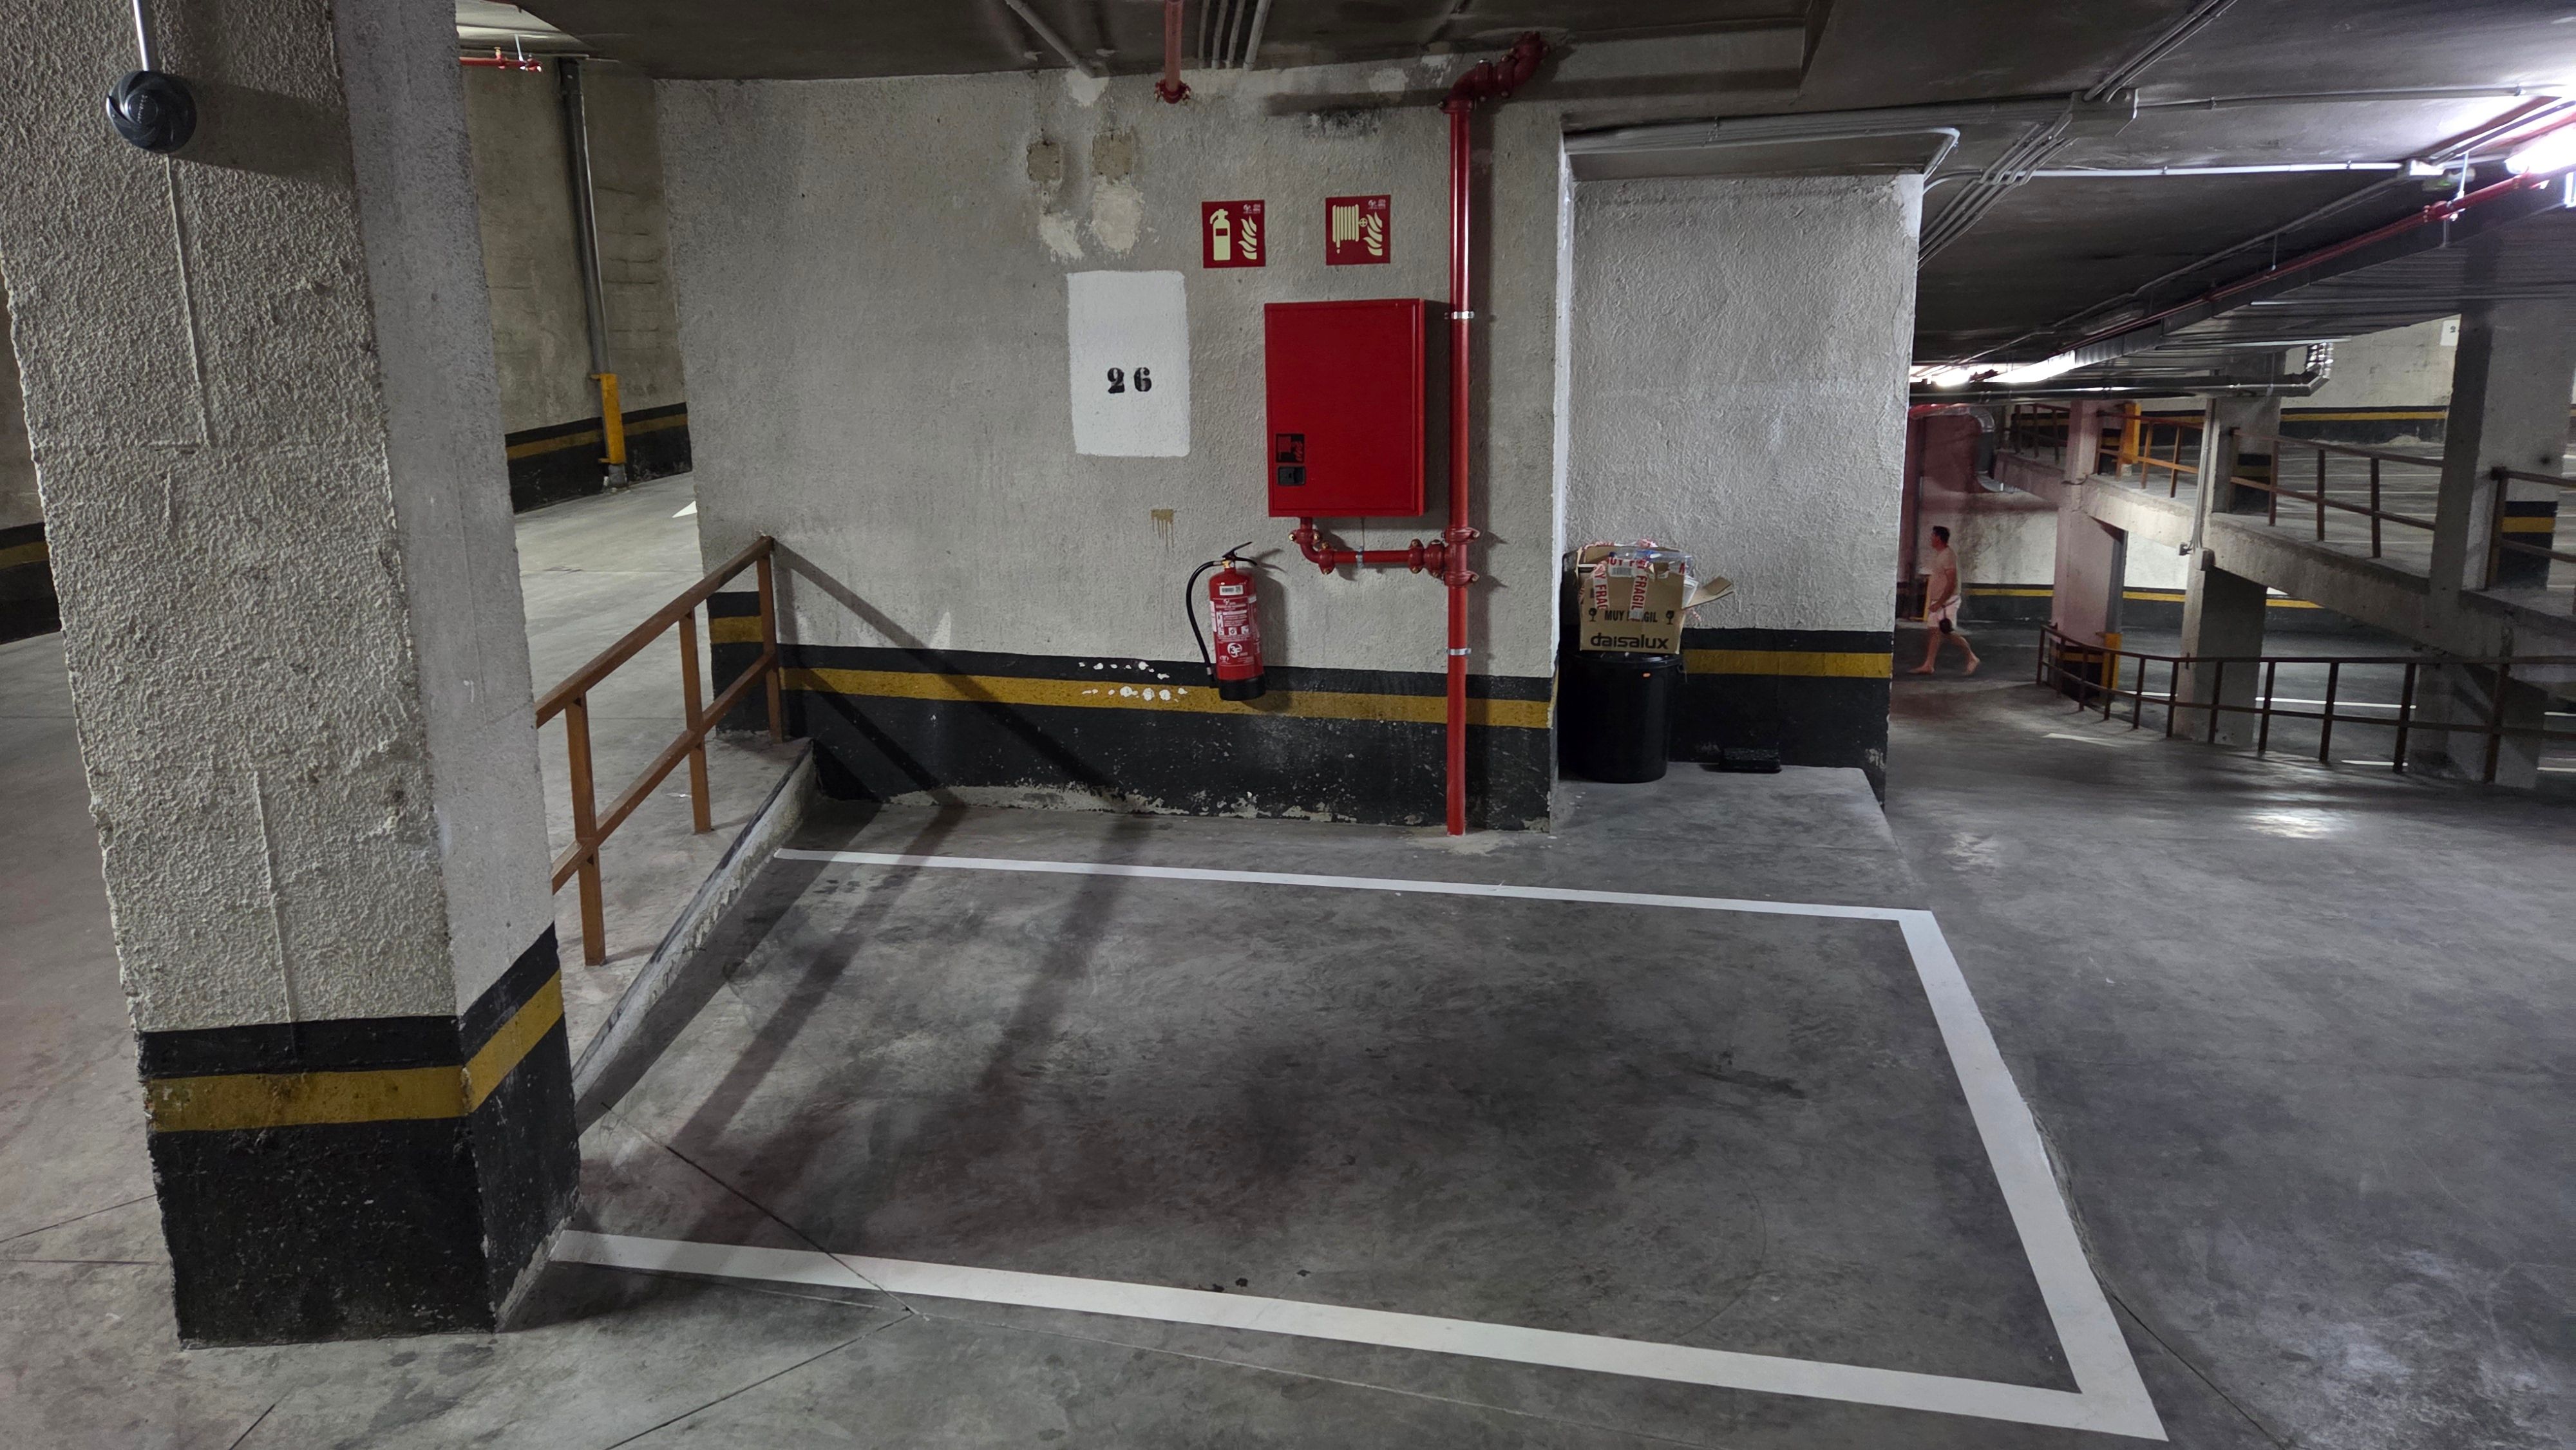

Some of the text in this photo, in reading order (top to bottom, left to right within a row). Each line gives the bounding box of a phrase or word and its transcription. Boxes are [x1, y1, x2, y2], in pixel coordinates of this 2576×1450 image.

[1107, 367, 1152, 393] 26
[1632, 576, 1647, 610] FRAGIL
[1605, 610, 1625, 621] MUY
[1590, 632, 1669, 650] daisalux
